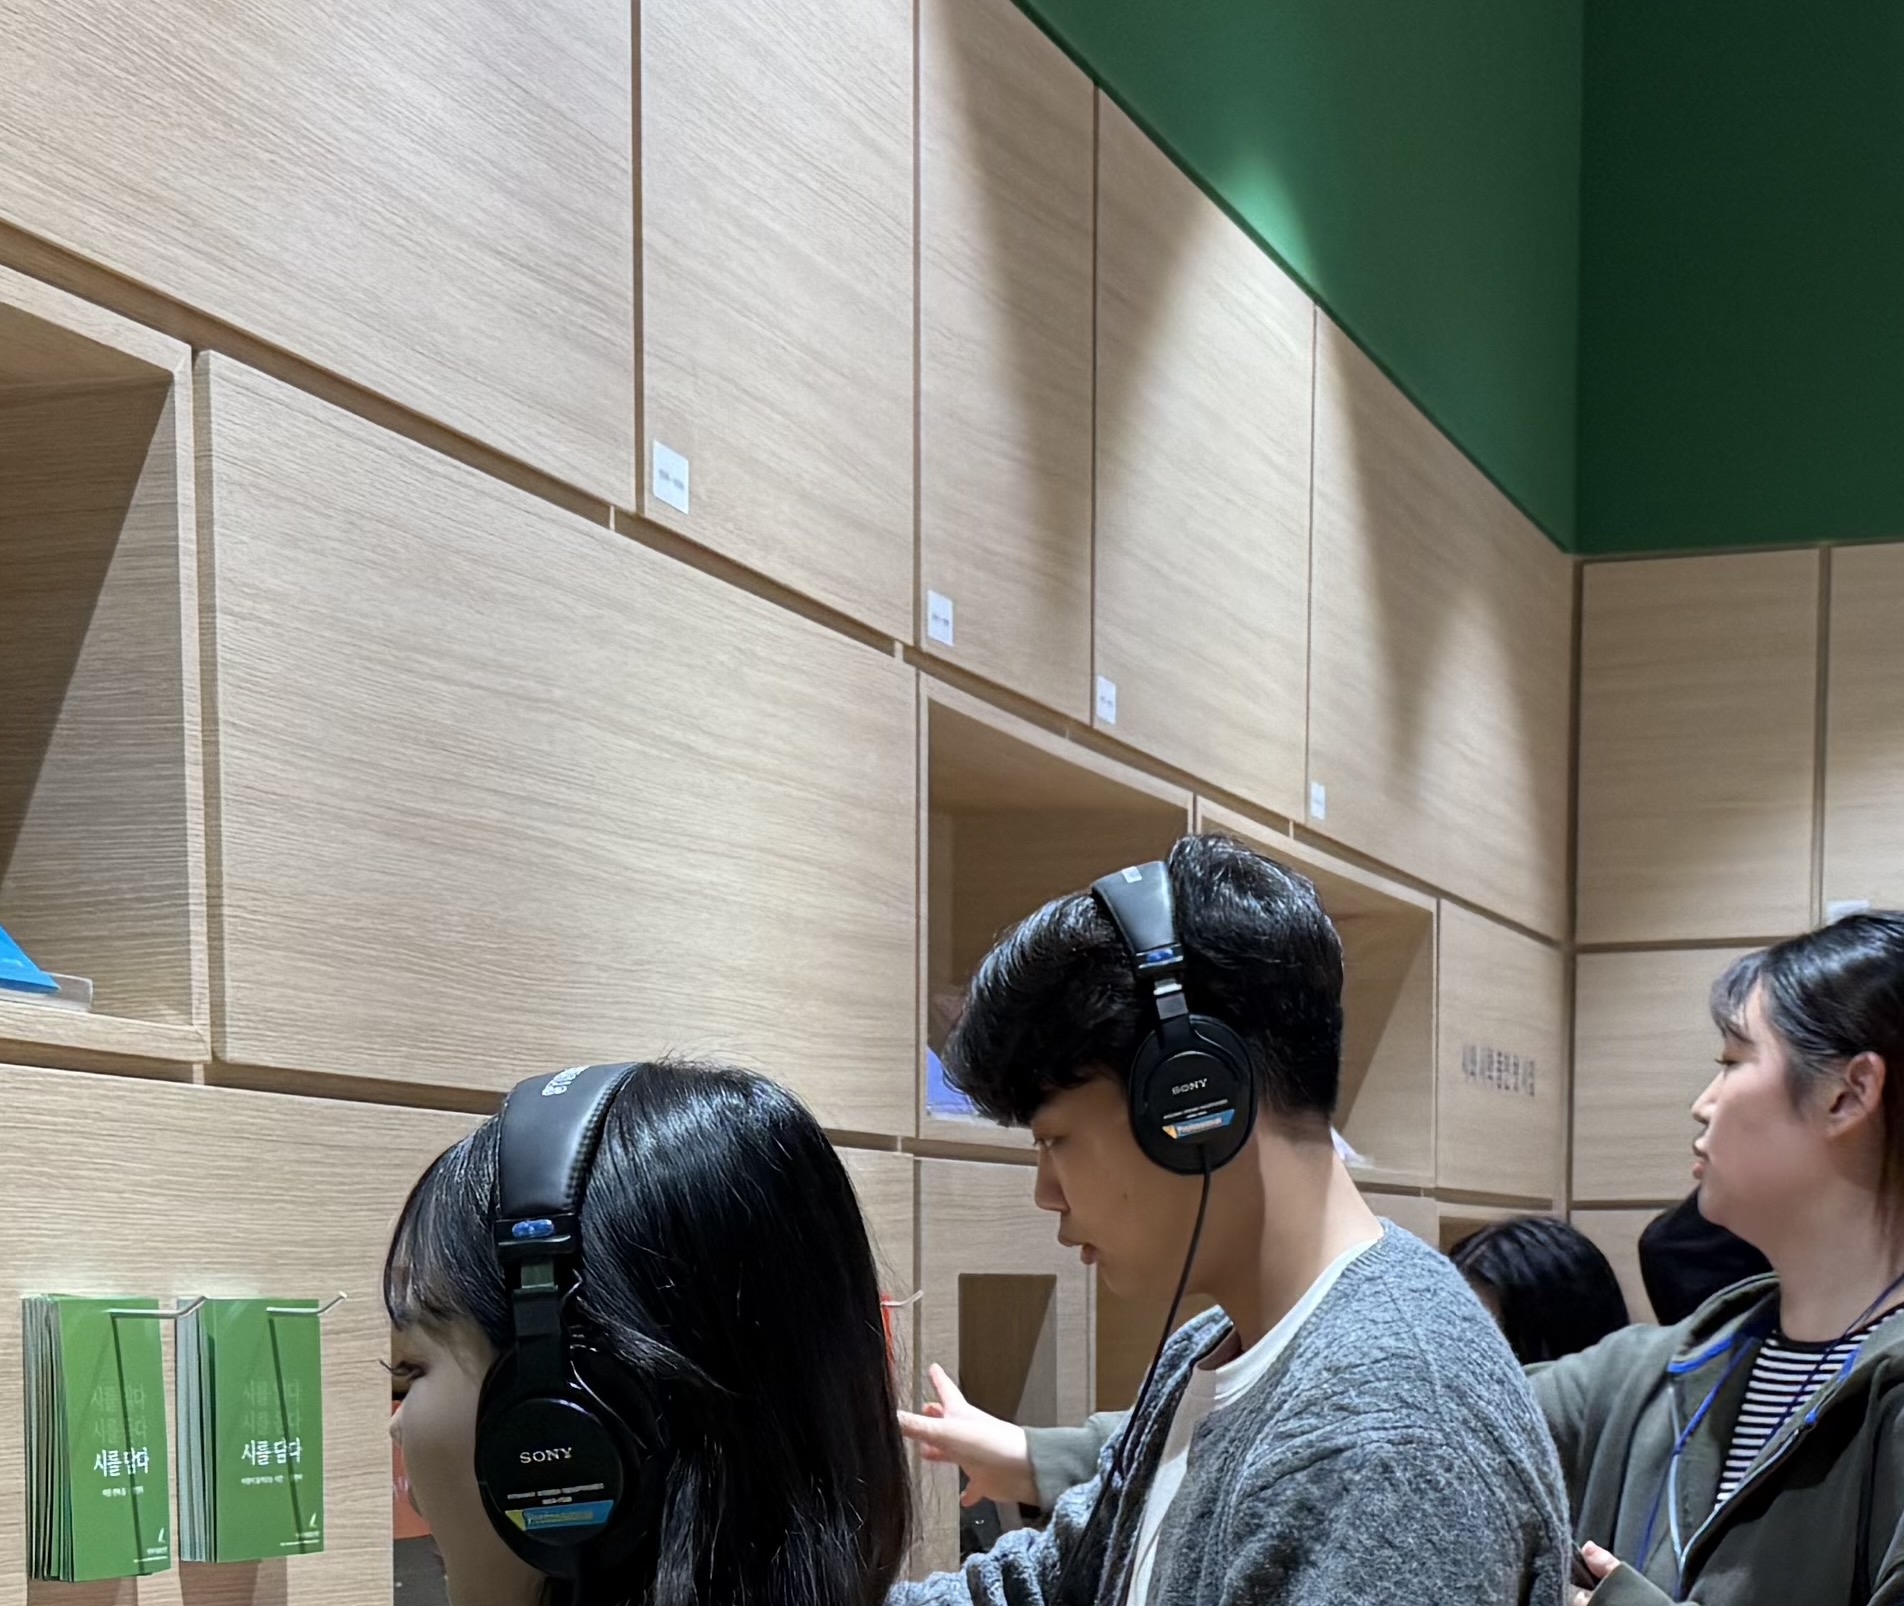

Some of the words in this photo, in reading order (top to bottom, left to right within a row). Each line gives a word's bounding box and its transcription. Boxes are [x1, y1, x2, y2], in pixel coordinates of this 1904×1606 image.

[1171, 1077, 1208, 1095] SONY
[94, 1449, 122, 1477] 시를
[123, 1447, 149, 1474] 담다
[241, 1440, 271, 1466] 시를
[274, 1437, 302, 1464] 담다
[519, 1447, 573, 1464] SONY
